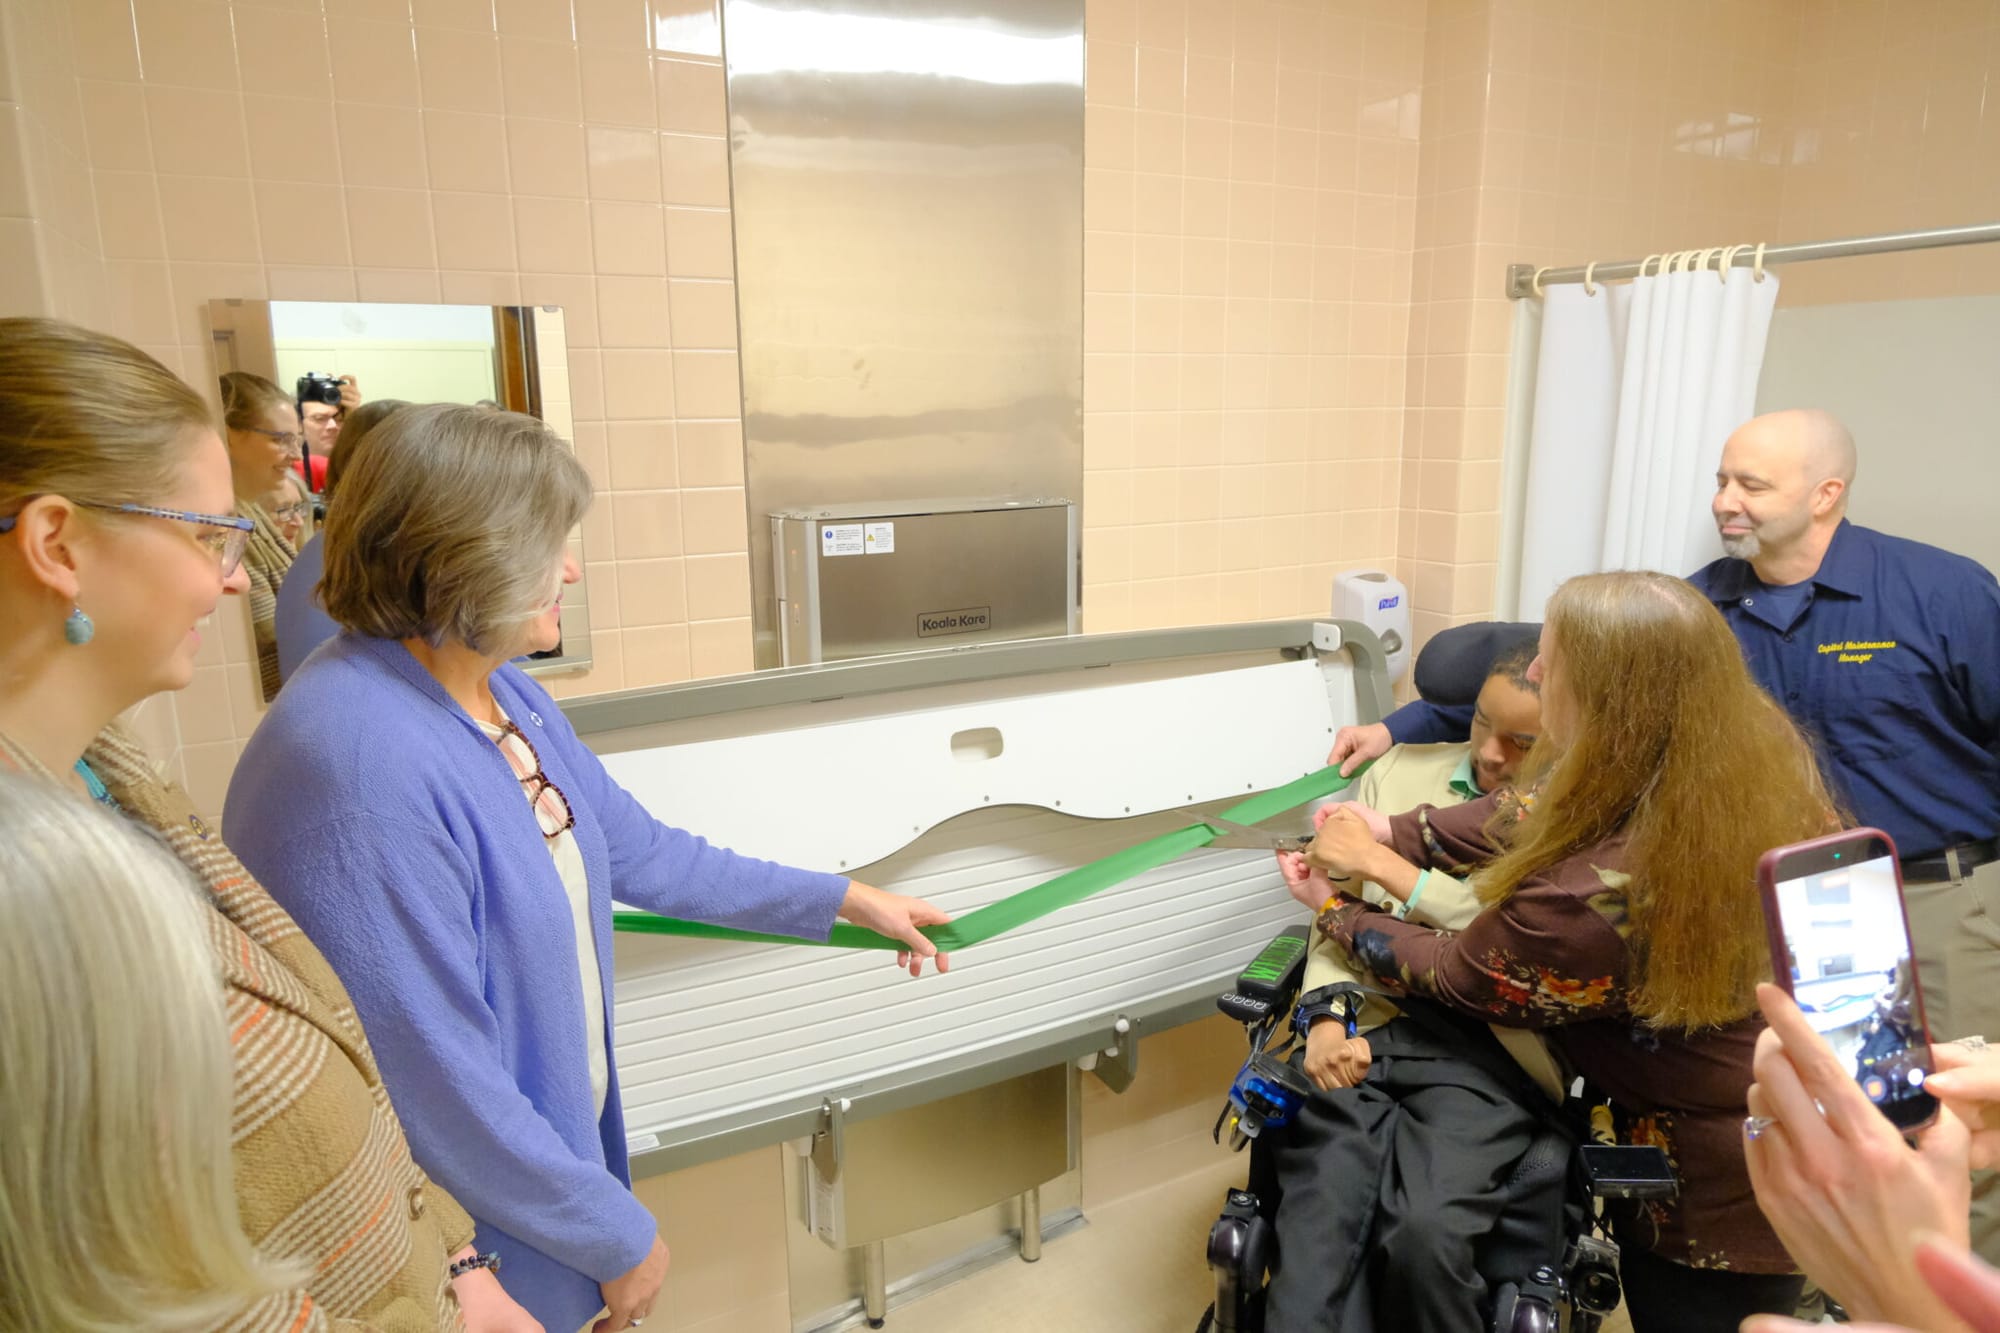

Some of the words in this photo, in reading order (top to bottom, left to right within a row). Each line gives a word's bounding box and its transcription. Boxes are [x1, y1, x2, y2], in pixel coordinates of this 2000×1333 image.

[922, 616, 957, 631] Koala
[959, 615, 986, 627] Kare
[1844, 641, 1896, 650] Maintenance
[1838, 653, 1872, 664] Manager
